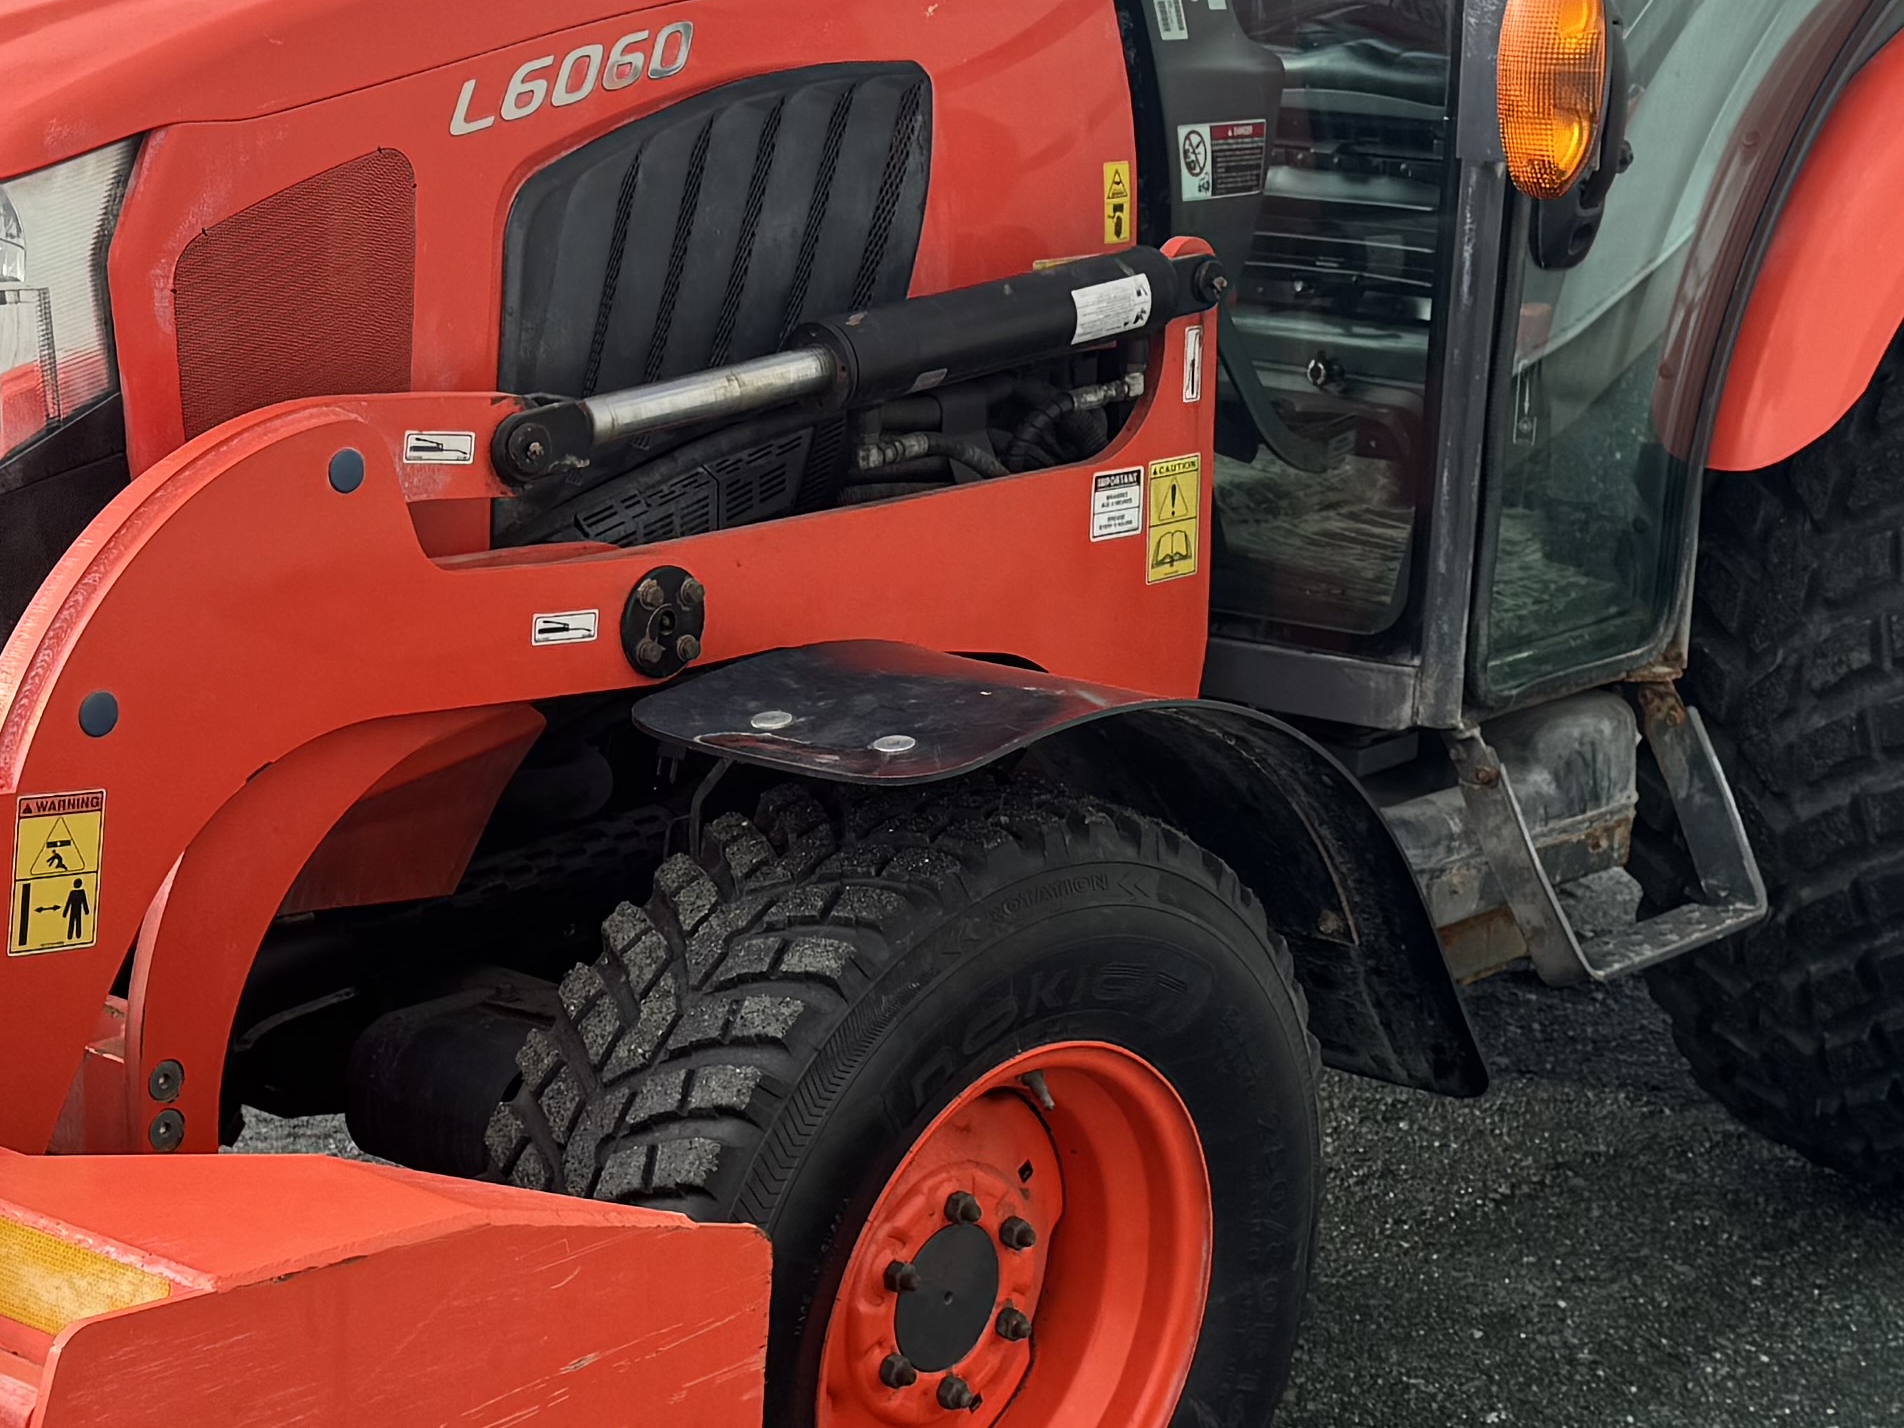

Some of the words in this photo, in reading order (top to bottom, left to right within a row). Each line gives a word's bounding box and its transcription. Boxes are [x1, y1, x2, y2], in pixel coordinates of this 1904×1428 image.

[449, 21, 694, 136] L6060
[1158, 460, 1196, 475] CAUTION
[1097, 472, 1138, 488] IMPORTANT
[36, 795, 101, 813] WARNING
